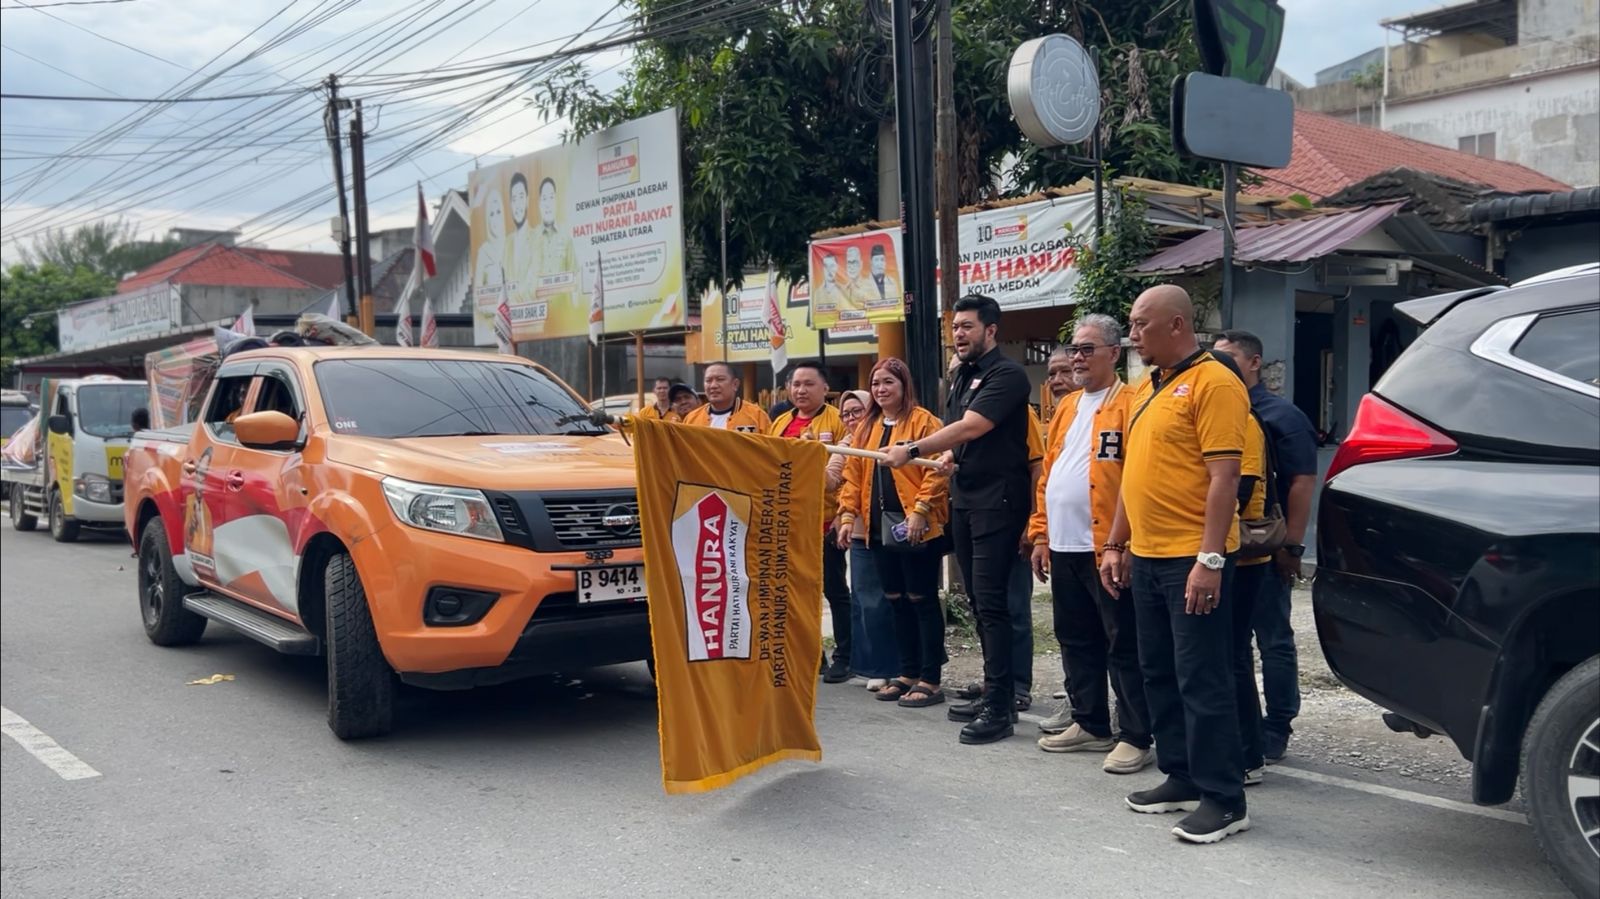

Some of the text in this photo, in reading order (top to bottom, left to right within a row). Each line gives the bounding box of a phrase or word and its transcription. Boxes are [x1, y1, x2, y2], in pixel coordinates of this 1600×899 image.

[576, 181, 668, 212] DEWAN PIMPINAN DAERAH
[603, 200, 637, 218] PARTAI
[573, 204, 673, 238] HATI NURANI RAKYAT
[978, 225, 992, 242] 10
[591, 224, 653, 245] SUMATERA UTARA
[973, 245, 1027, 263] PIMPINAN
[997, 247, 1077, 280] HANUR
[968, 278, 1040, 295] KOTA MEDAN
[715, 328, 749, 344] PRTAI
[335, 421, 357, 429] ONE
[1098, 431, 1124, 460] H
[581, 567, 639, 589] B 9414
[701, 514, 722, 650] HANURA
[728, 520, 741, 650] PARTAI HATI NURANI RAKYAT
[759, 489, 775, 660] DEWAN PIMPINAN DAERAH
[773, 461, 792, 688] PARTAI HANURA SUMATERA UTARA
